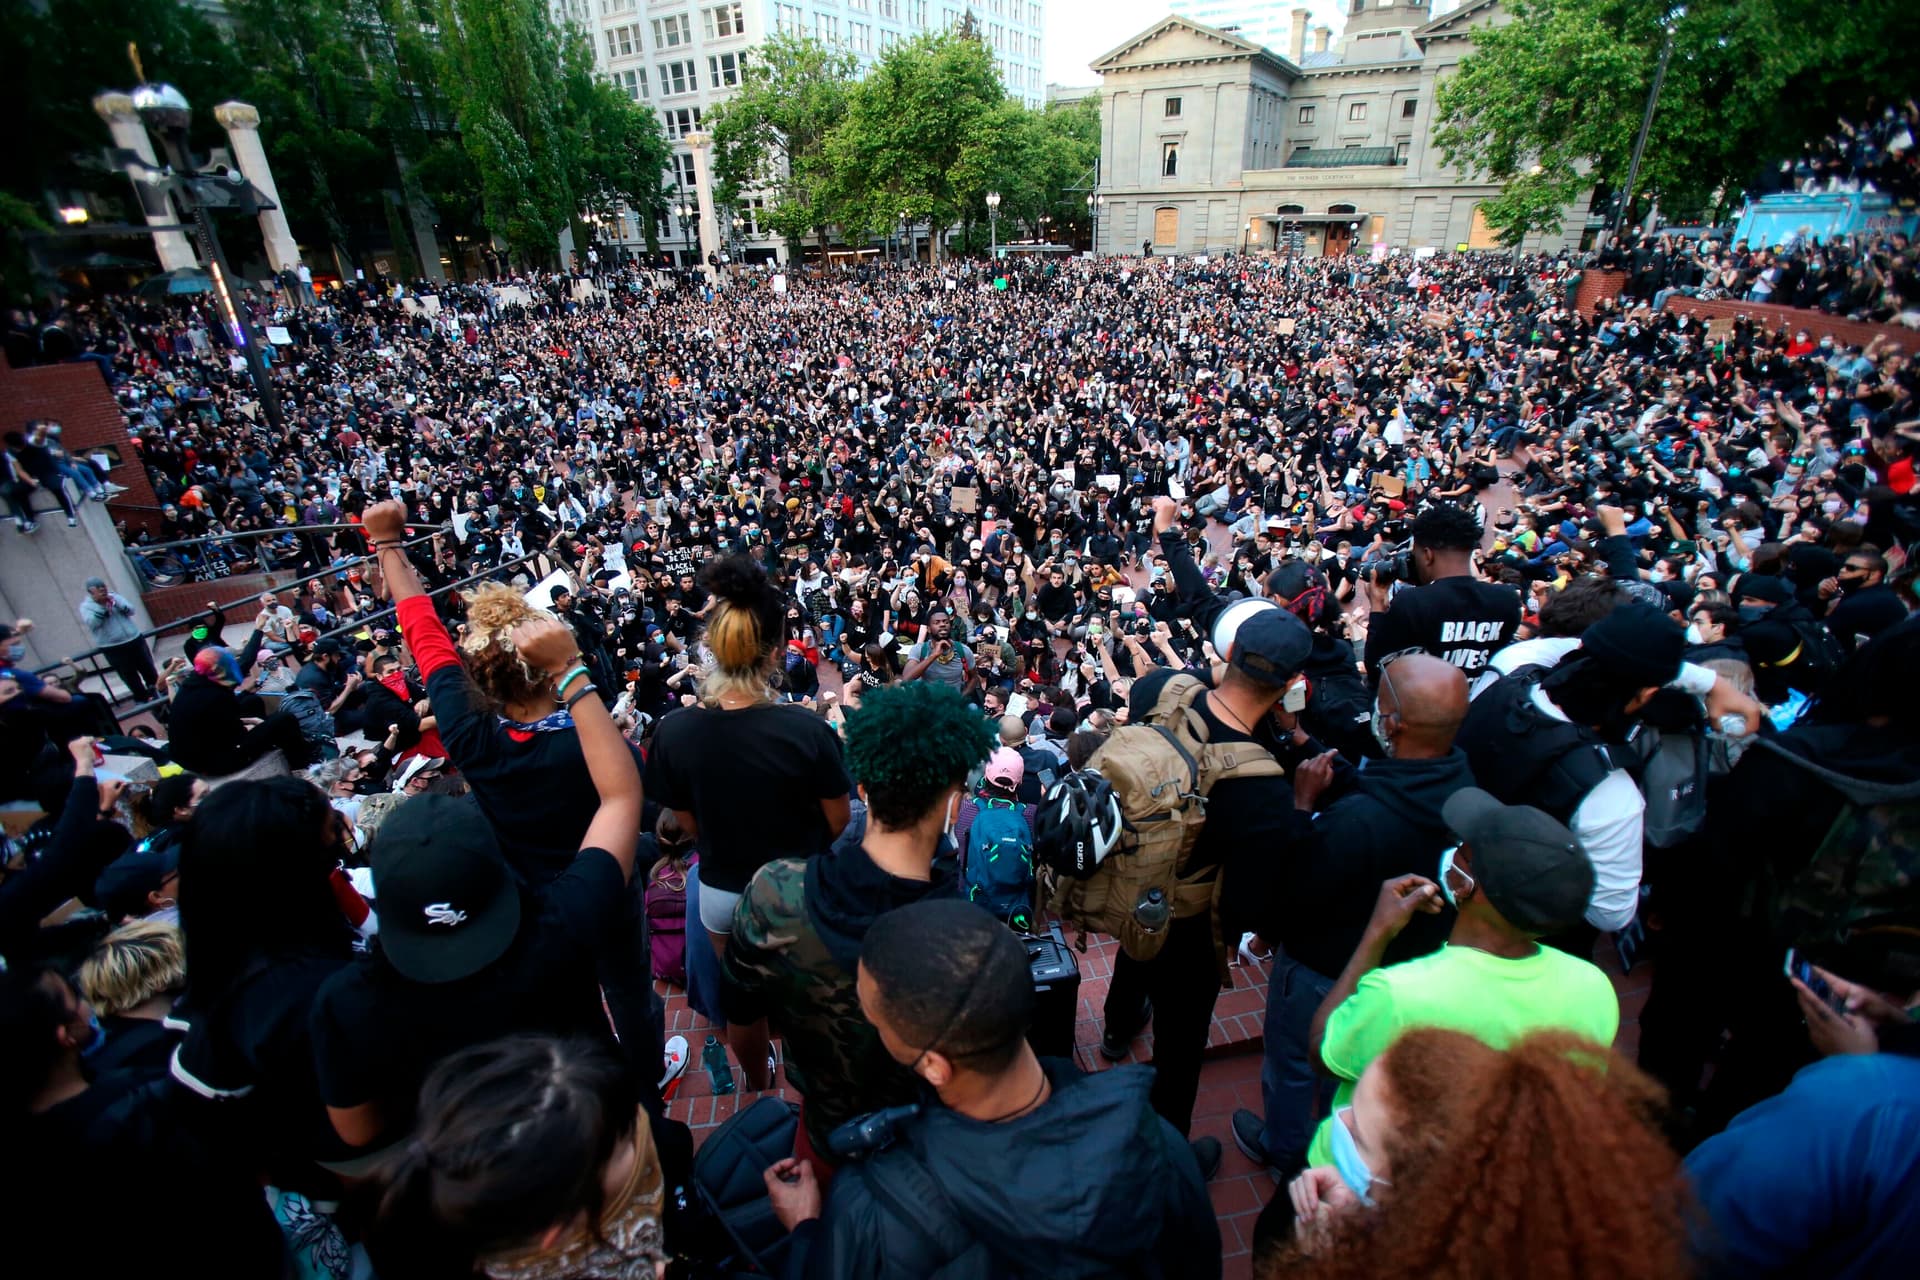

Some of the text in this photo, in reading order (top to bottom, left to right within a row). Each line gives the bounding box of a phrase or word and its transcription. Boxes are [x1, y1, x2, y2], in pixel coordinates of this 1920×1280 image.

[665, 562, 688, 572] BLACK
[1440, 621, 1504, 642] BLACK
[1443, 649, 1490, 670] LIVES
